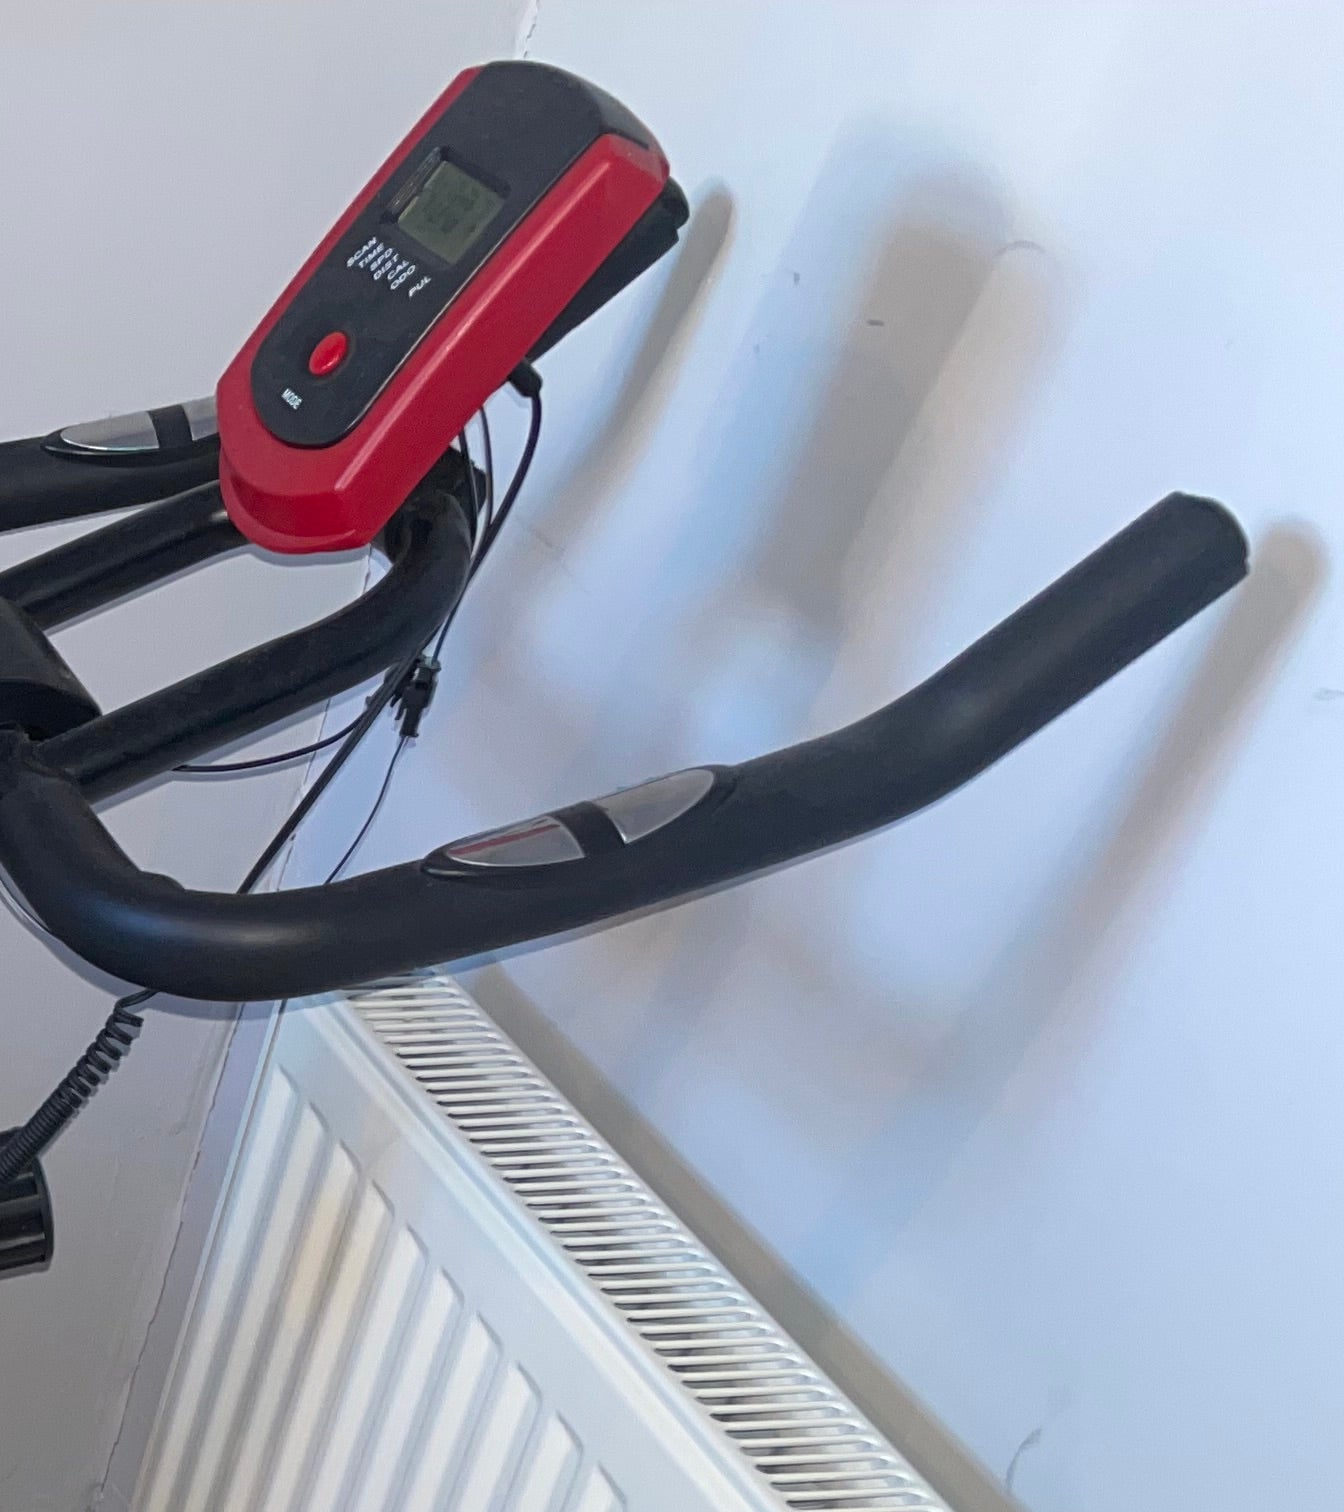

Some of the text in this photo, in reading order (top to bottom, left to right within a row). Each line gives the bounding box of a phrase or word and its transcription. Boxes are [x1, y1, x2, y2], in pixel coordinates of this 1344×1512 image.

[347, 237, 377, 267] SCAN
[358, 243, 384, 268] TIME
[370, 248, 393, 271] SPD
[373, 254, 399, 280] DIST
[387, 260, 409, 280] CAL
[391, 265, 416, 290] ODO
[408, 276, 431, 297] PUL
[282, 388, 302, 410] MODE
